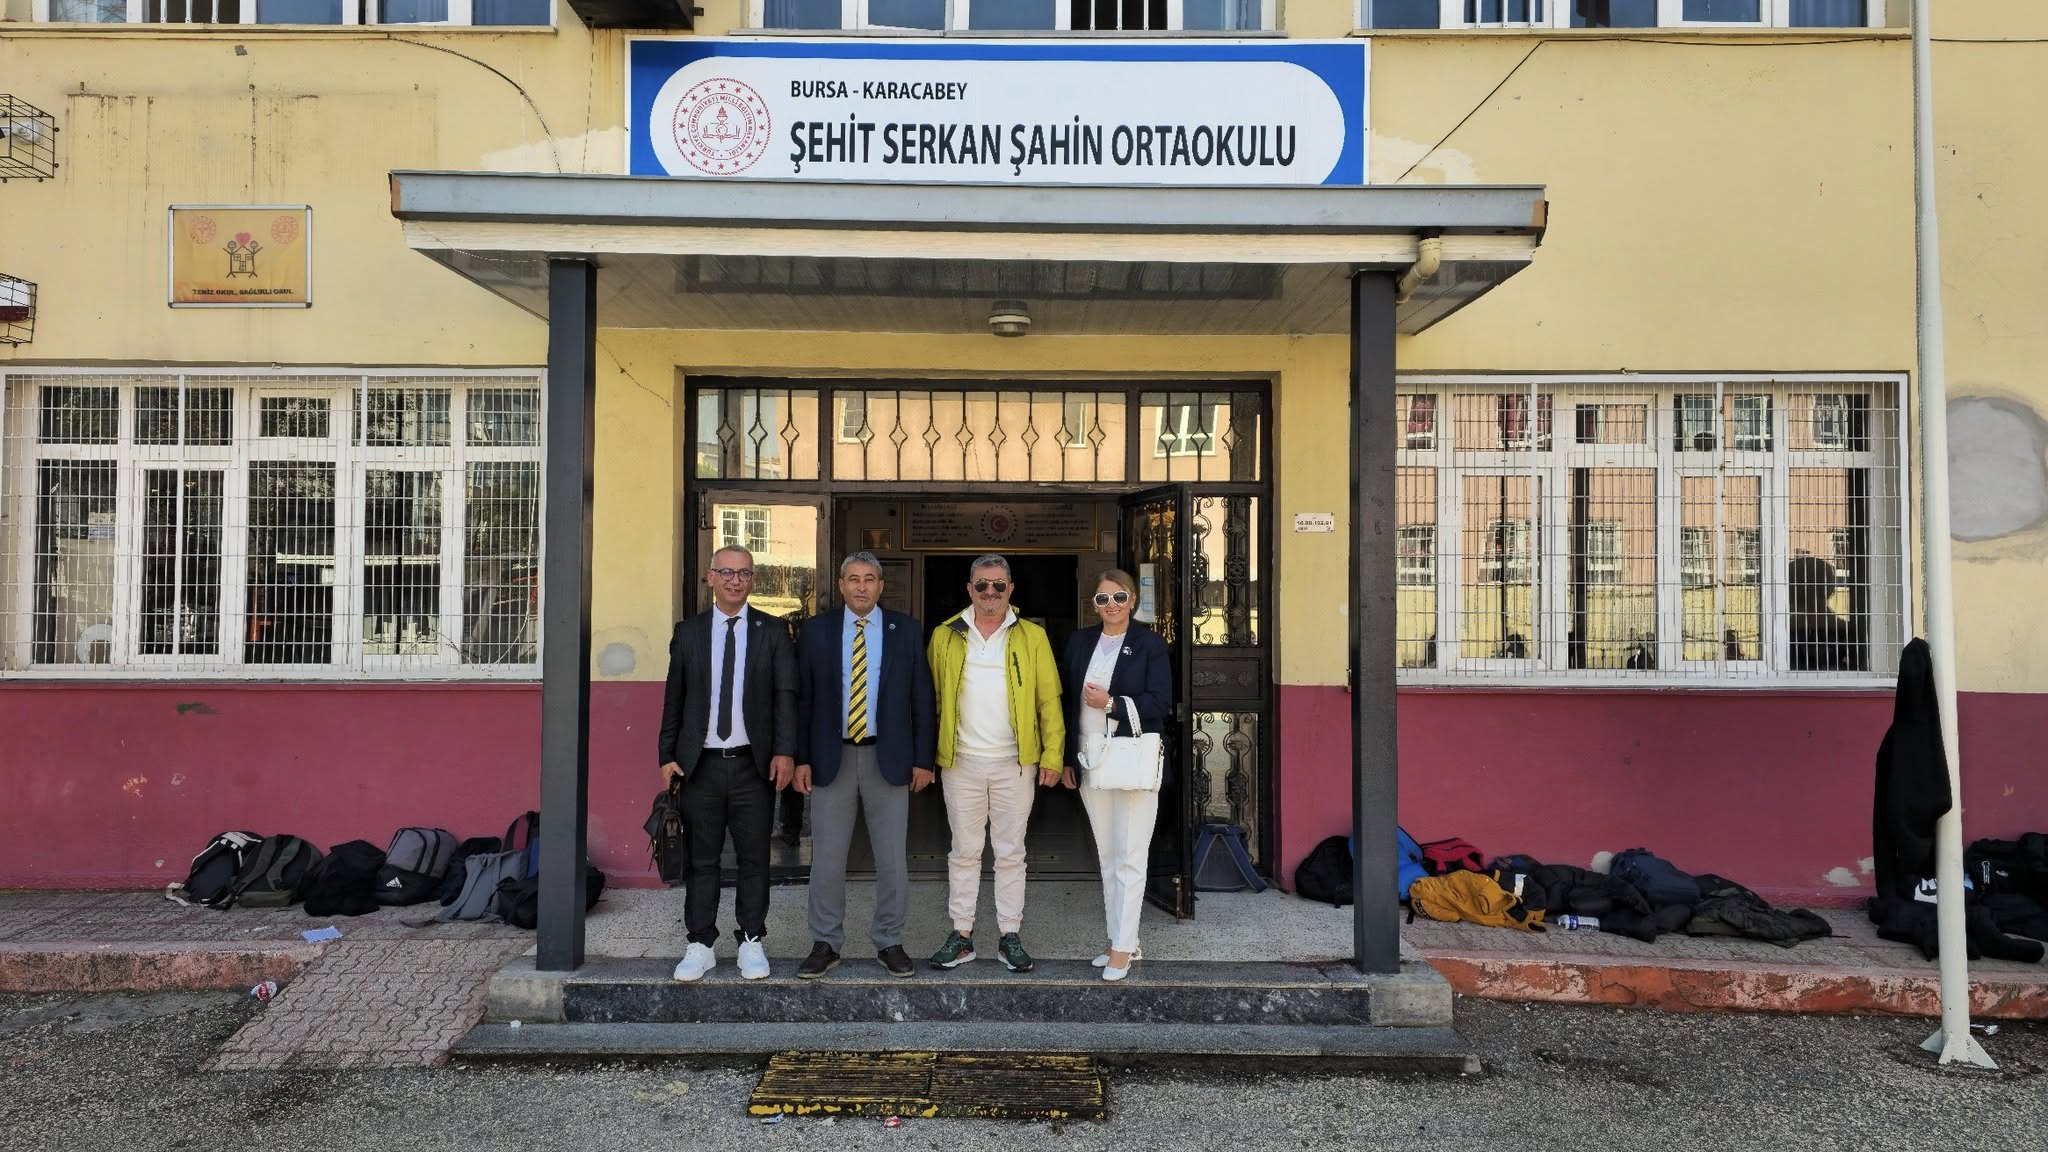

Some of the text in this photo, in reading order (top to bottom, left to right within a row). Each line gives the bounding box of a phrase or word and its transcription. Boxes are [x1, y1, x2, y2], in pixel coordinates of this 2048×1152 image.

[791, 80, 849, 99] BURSA
[863, 81, 968, 100] KARACABEY
[790, 112, 1296, 177] ŞEHİT SERKAN ŞAHİN ORTAOKULU
